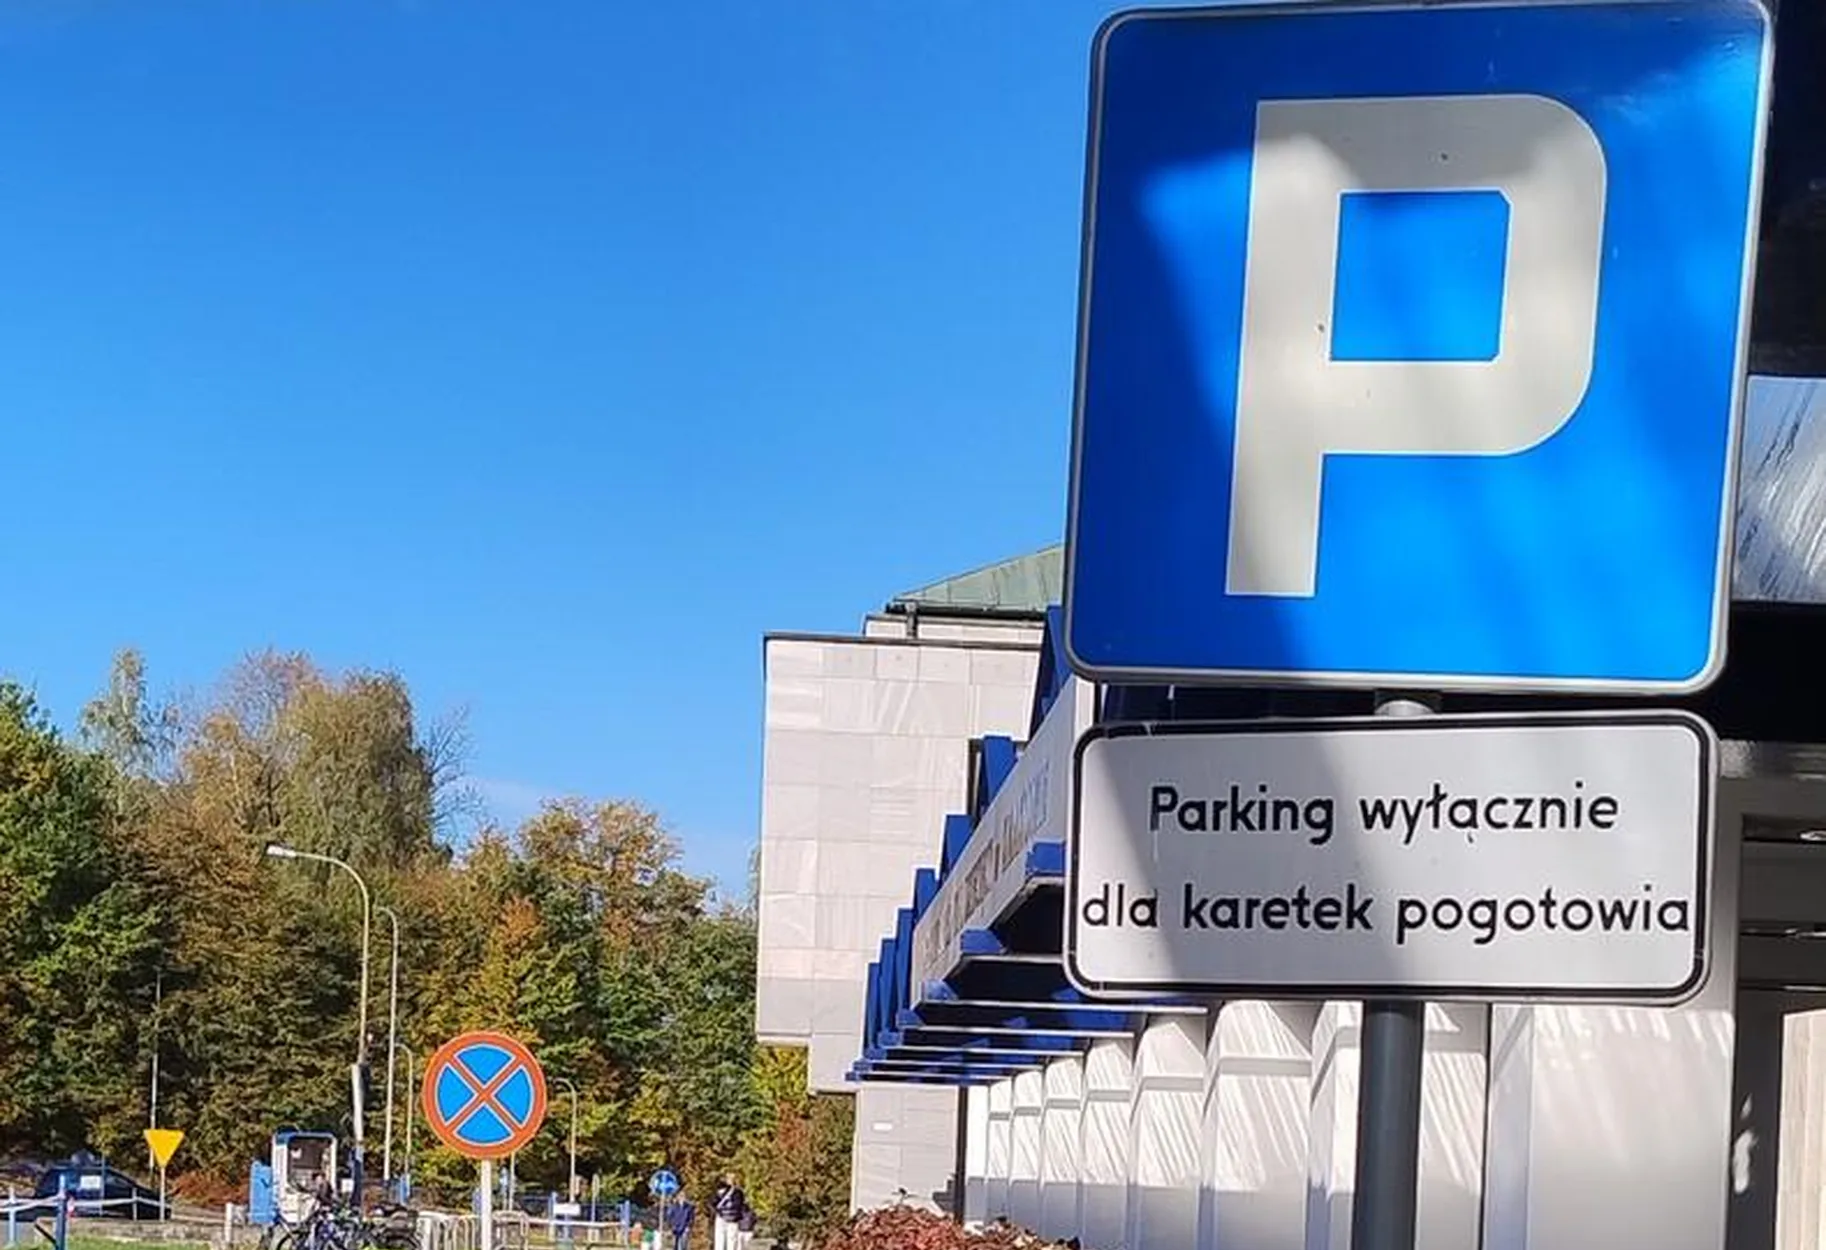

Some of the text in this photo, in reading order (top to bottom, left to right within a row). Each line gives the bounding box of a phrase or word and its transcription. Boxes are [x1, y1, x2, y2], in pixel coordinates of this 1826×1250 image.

[1225, 94, 1607, 598] P
[1149, 781, 1619, 845] Parking wyłącznie
[1082, 884, 1690, 945] dla karetek pogotowia
